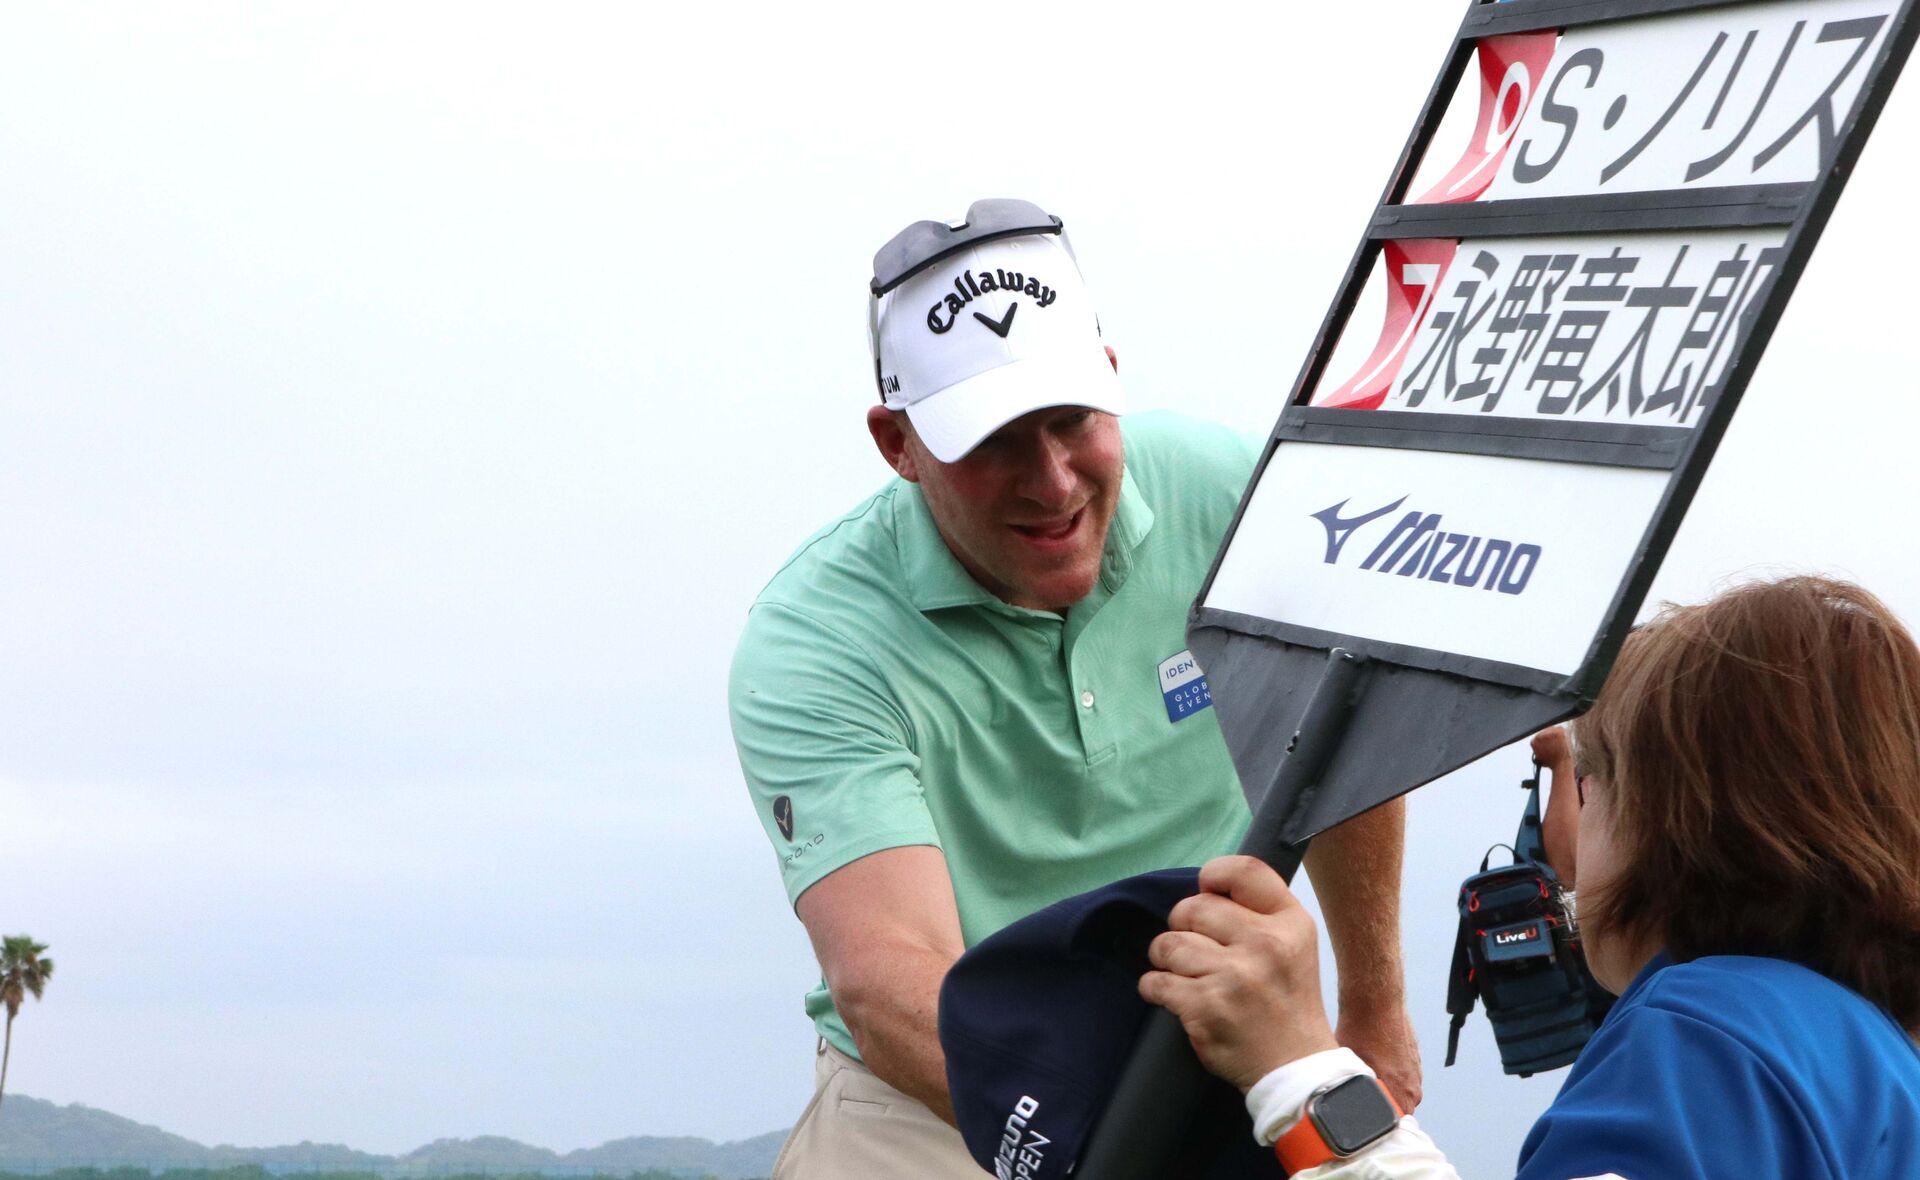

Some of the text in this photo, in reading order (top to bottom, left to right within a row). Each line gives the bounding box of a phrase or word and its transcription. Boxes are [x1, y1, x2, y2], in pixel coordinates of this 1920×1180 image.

[1447, 61, 1530, 195] 9
[927, 268, 1057, 335] Callaway
[1351, 243, 1783, 424] 7 永野竜太郎
[1175, 682, 1208, 702] GLOB
[1178, 692, 1211, 712] EVEN
